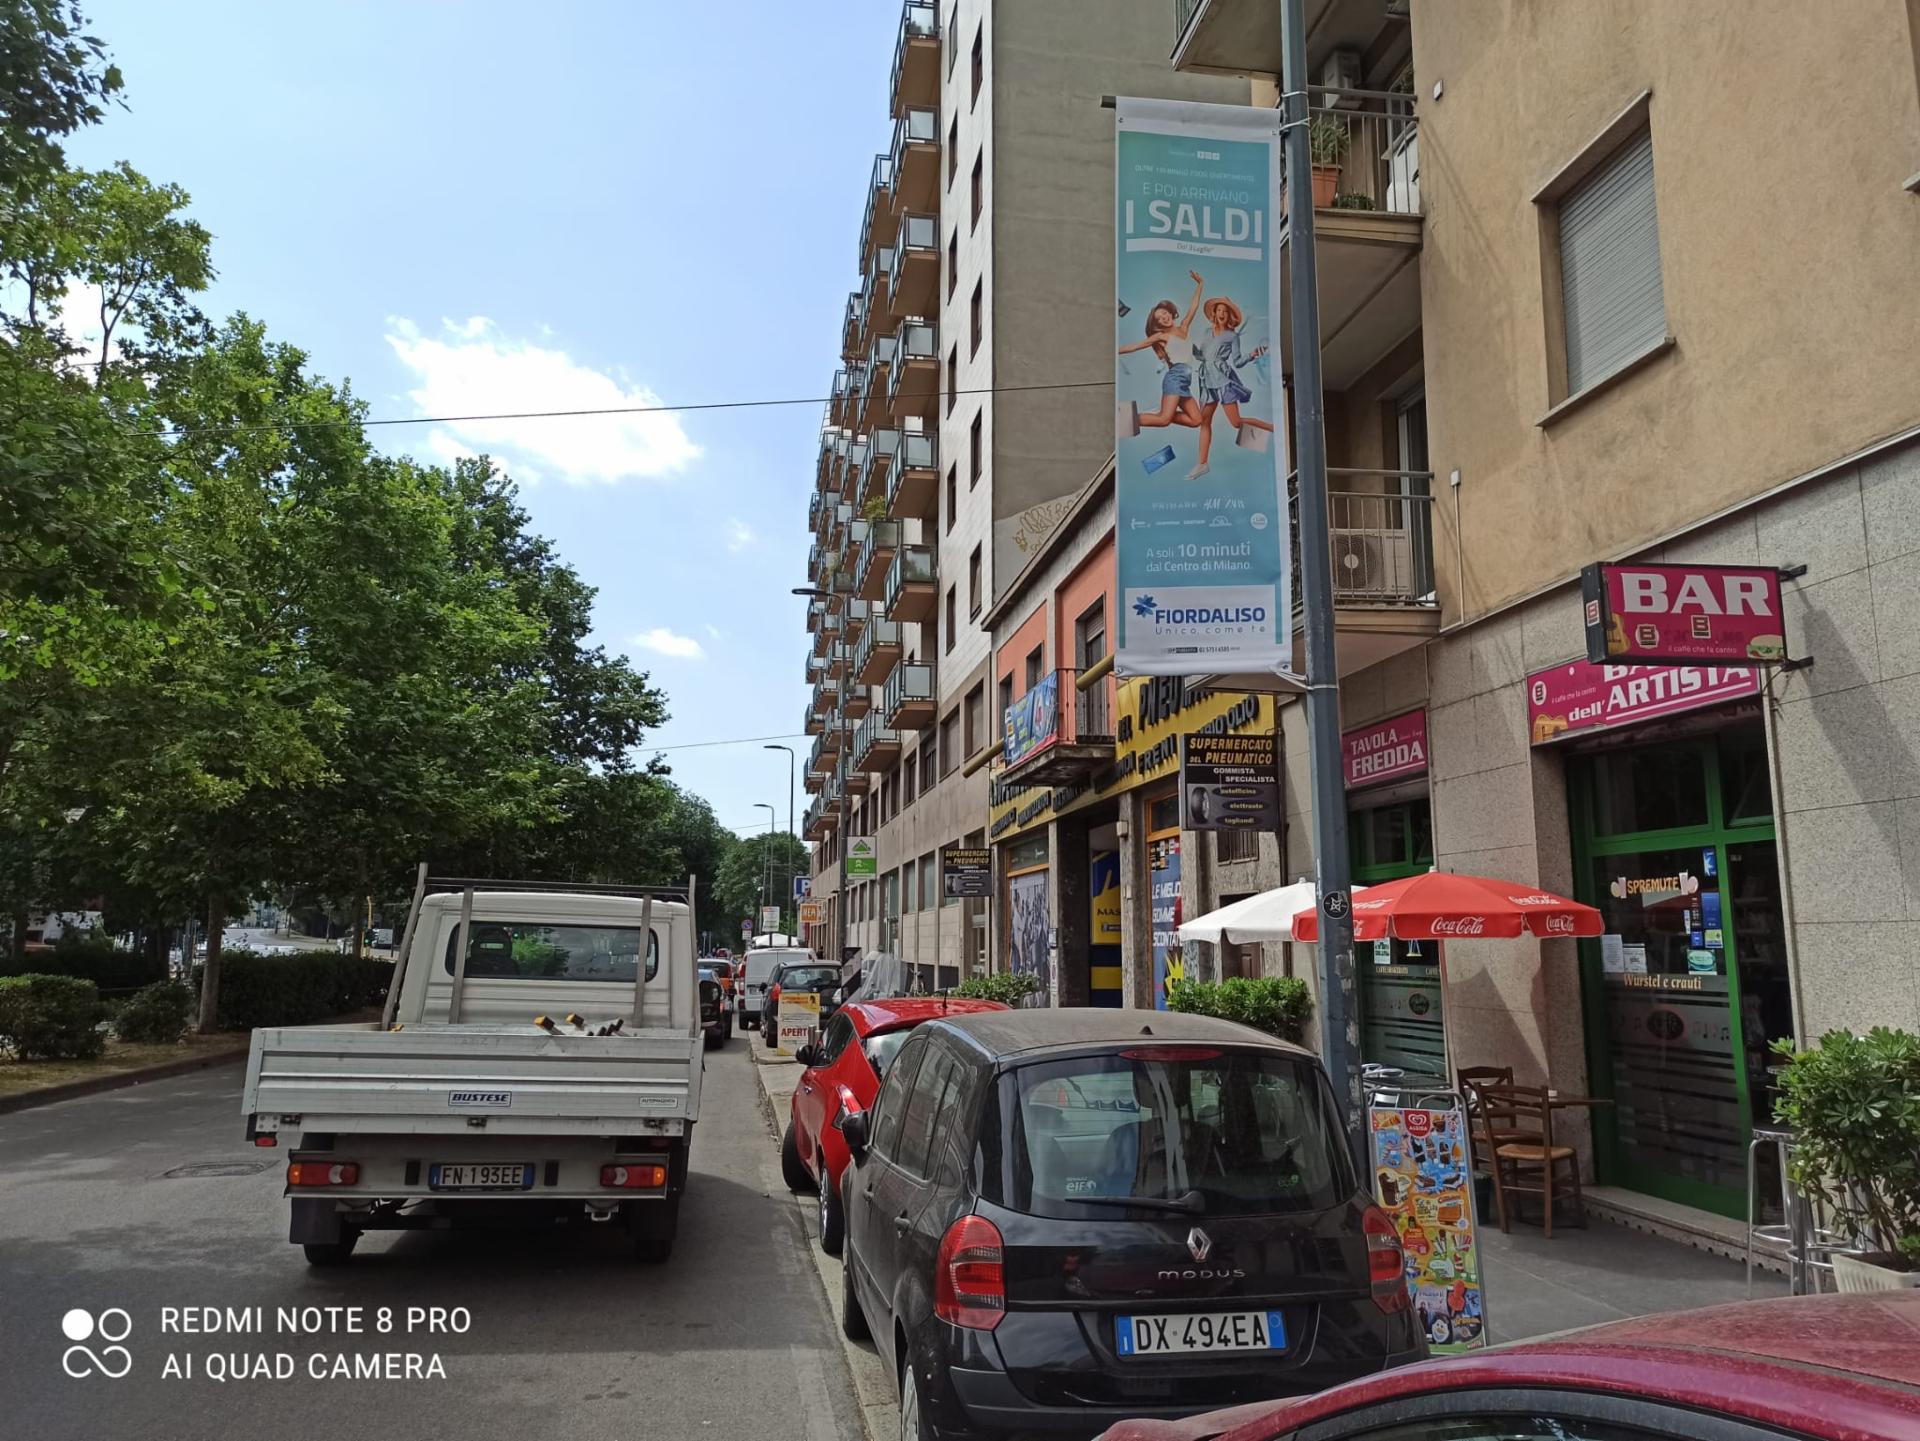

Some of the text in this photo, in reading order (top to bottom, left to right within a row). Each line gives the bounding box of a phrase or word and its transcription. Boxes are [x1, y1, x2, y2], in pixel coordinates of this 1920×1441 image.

[1143, 182, 1249, 205] E POI ARRIVANO
[1125, 199, 1262, 243] I SALDI
[1146, 541, 1251, 559] A soli 10 minuti
[1146, 561, 1162, 573] dal
[1164, 561, 1200, 572] Centro
[1202, 560, 1212, 571] di
[1619, 572, 1773, 617] BAR
[1155, 607, 1266, 624] FIORDALISO
[1205, 625, 1243, 635] come
[1251, 624, 1266, 634] te
[1226, 693, 1260, 731] OLIO
[1189, 737, 1273, 750] SUPERMERCATO
[1350, 728, 1398, 755] TAVOLA
[1205, 752, 1273, 765] PNEUMATICO
[1351, 740, 1425, 777] FREDDA
[1626, 876, 1680, 895] SPREMUTE
[1623, 973, 1702, 990] Wurstel e crauti
[451, 1093, 509, 1102] BUSTESE
[442, 1166, 463, 1185] FN
[470, 1166, 523, 1185] 193EE
[1135, 1317, 1170, 1351] DX
[1182, 1314, 1267, 1349] 494EA
